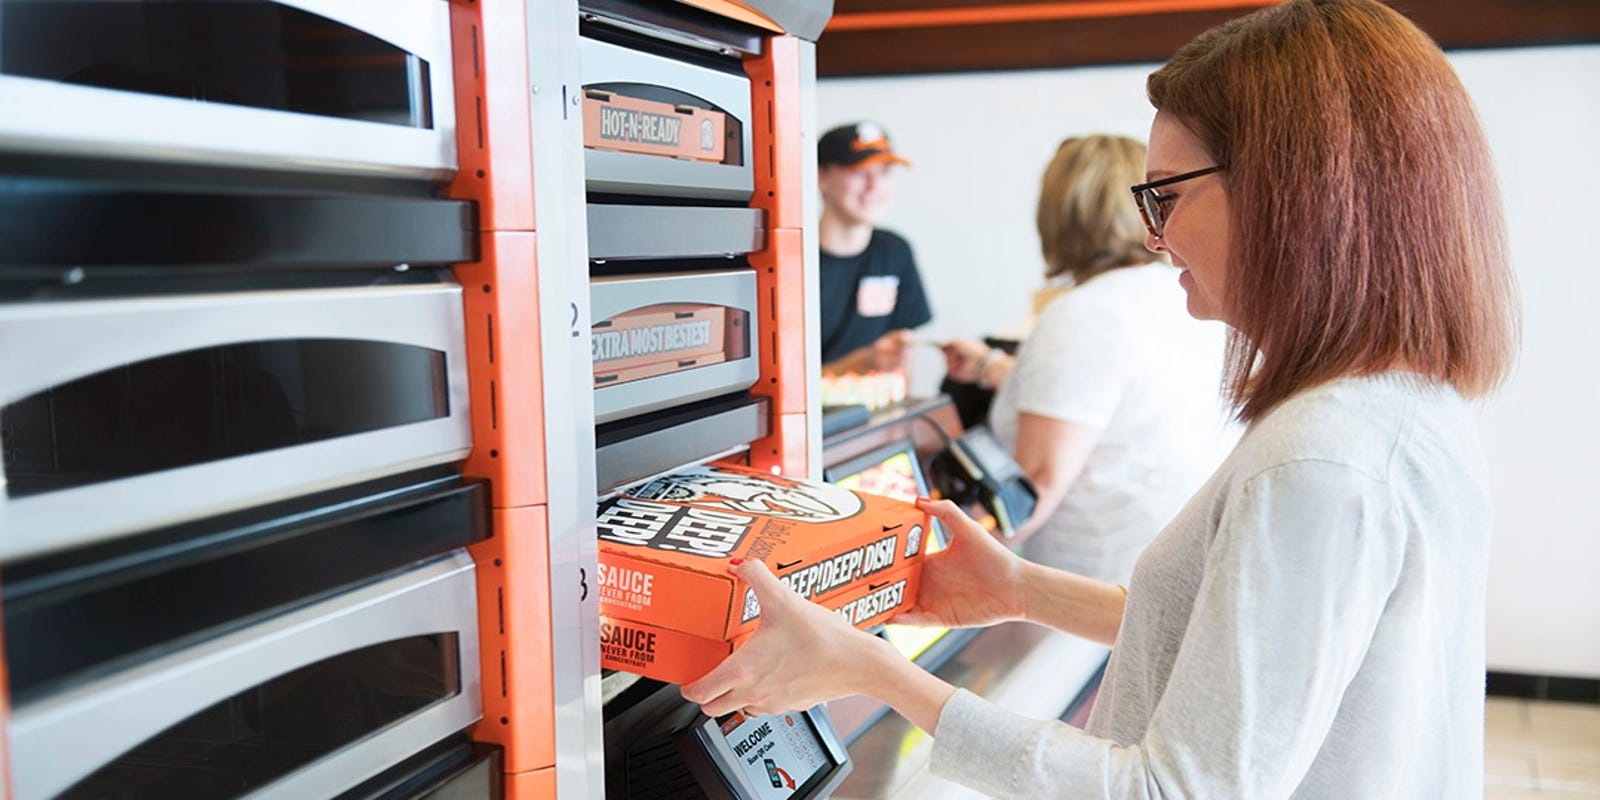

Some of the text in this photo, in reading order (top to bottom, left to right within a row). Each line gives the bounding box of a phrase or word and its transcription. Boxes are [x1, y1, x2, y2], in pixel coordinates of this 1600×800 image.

[601, 107, 681, 146] HOT-N-READY
[630, 326, 663, 355] MOST
[663, 320, 712, 351] BESTEST
[658, 507, 756, 558] DEEP!
[862, 535, 898, 576] DISH
[597, 562, 654, 595] SAUCE
[598, 585, 652, 607] EVER FROM
[855, 579, 908, 625] BESTEST
[600, 623, 657, 653] SAUCE
[629, 650, 656, 664] FROM
[734, 722, 773, 757] WELCOME
